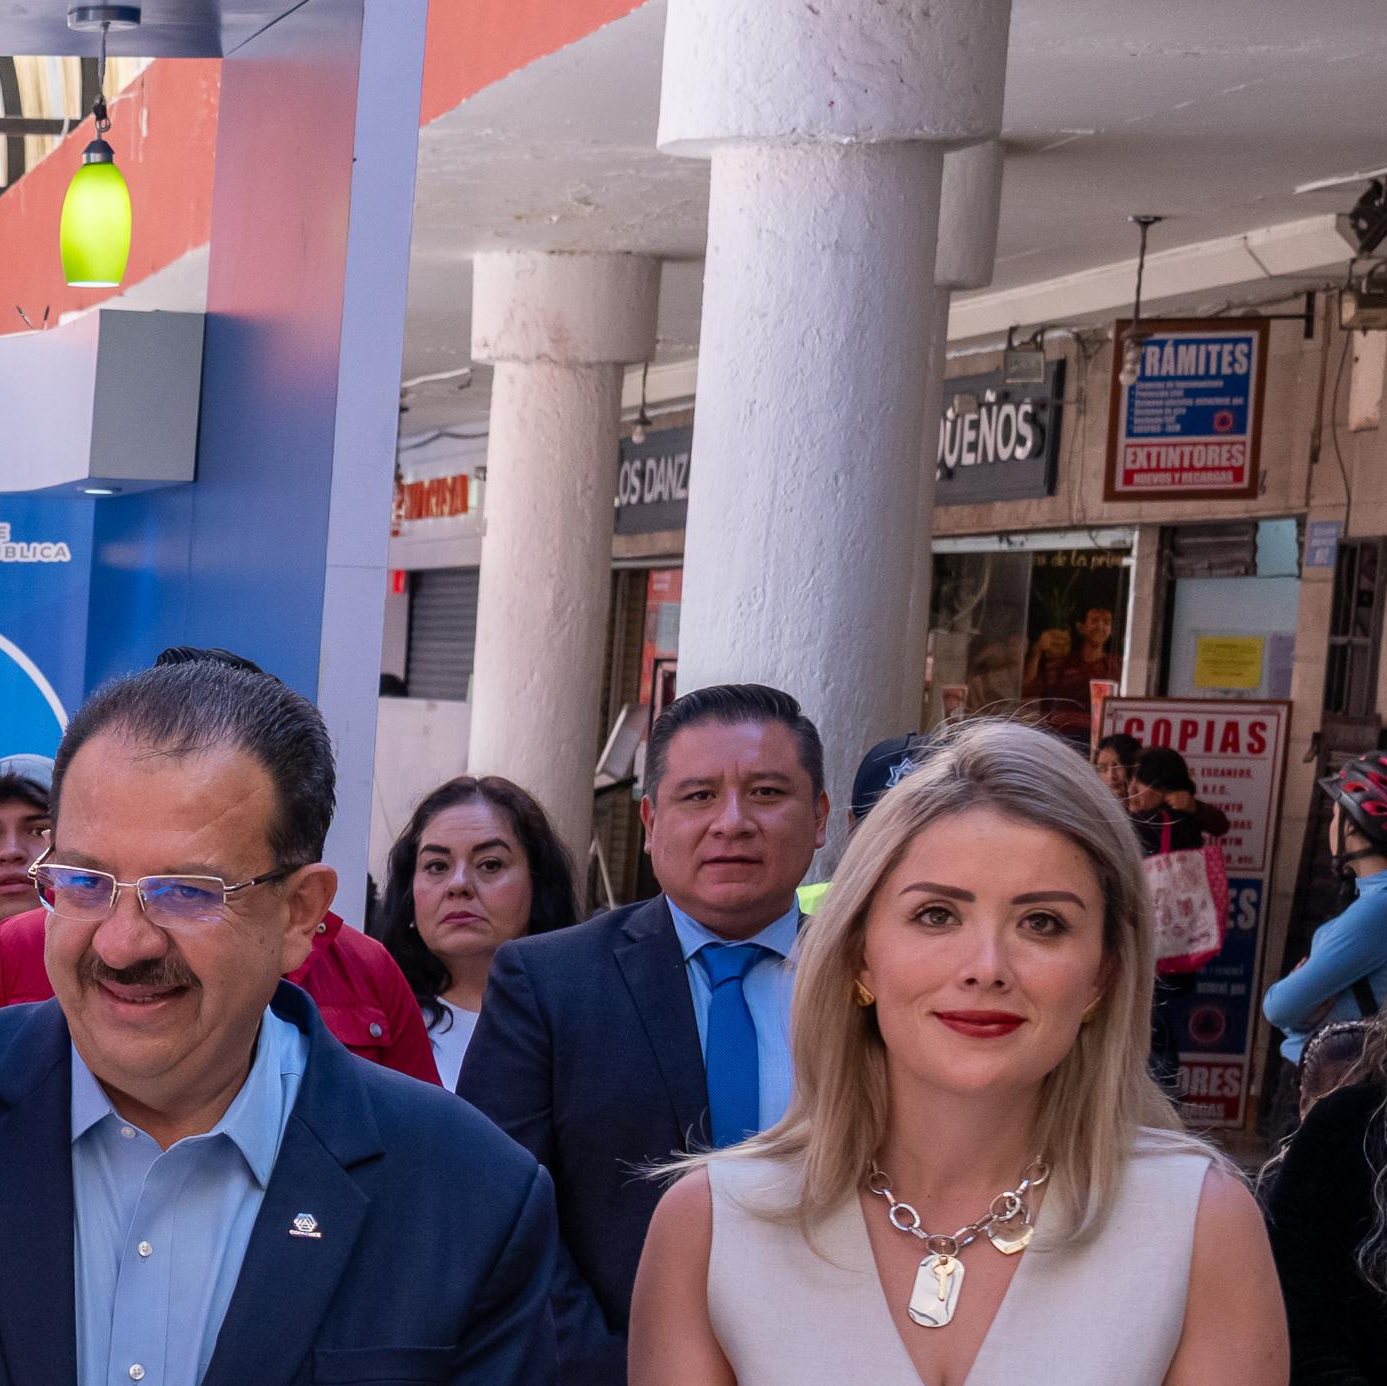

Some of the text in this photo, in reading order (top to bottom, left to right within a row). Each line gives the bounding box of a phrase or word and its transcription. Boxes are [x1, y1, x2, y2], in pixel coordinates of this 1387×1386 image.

[1125, 443, 1245, 470] EXTINTORES
[643, 452, 690, 504] DANZ
[1124, 717, 1268, 755] COPIAS
